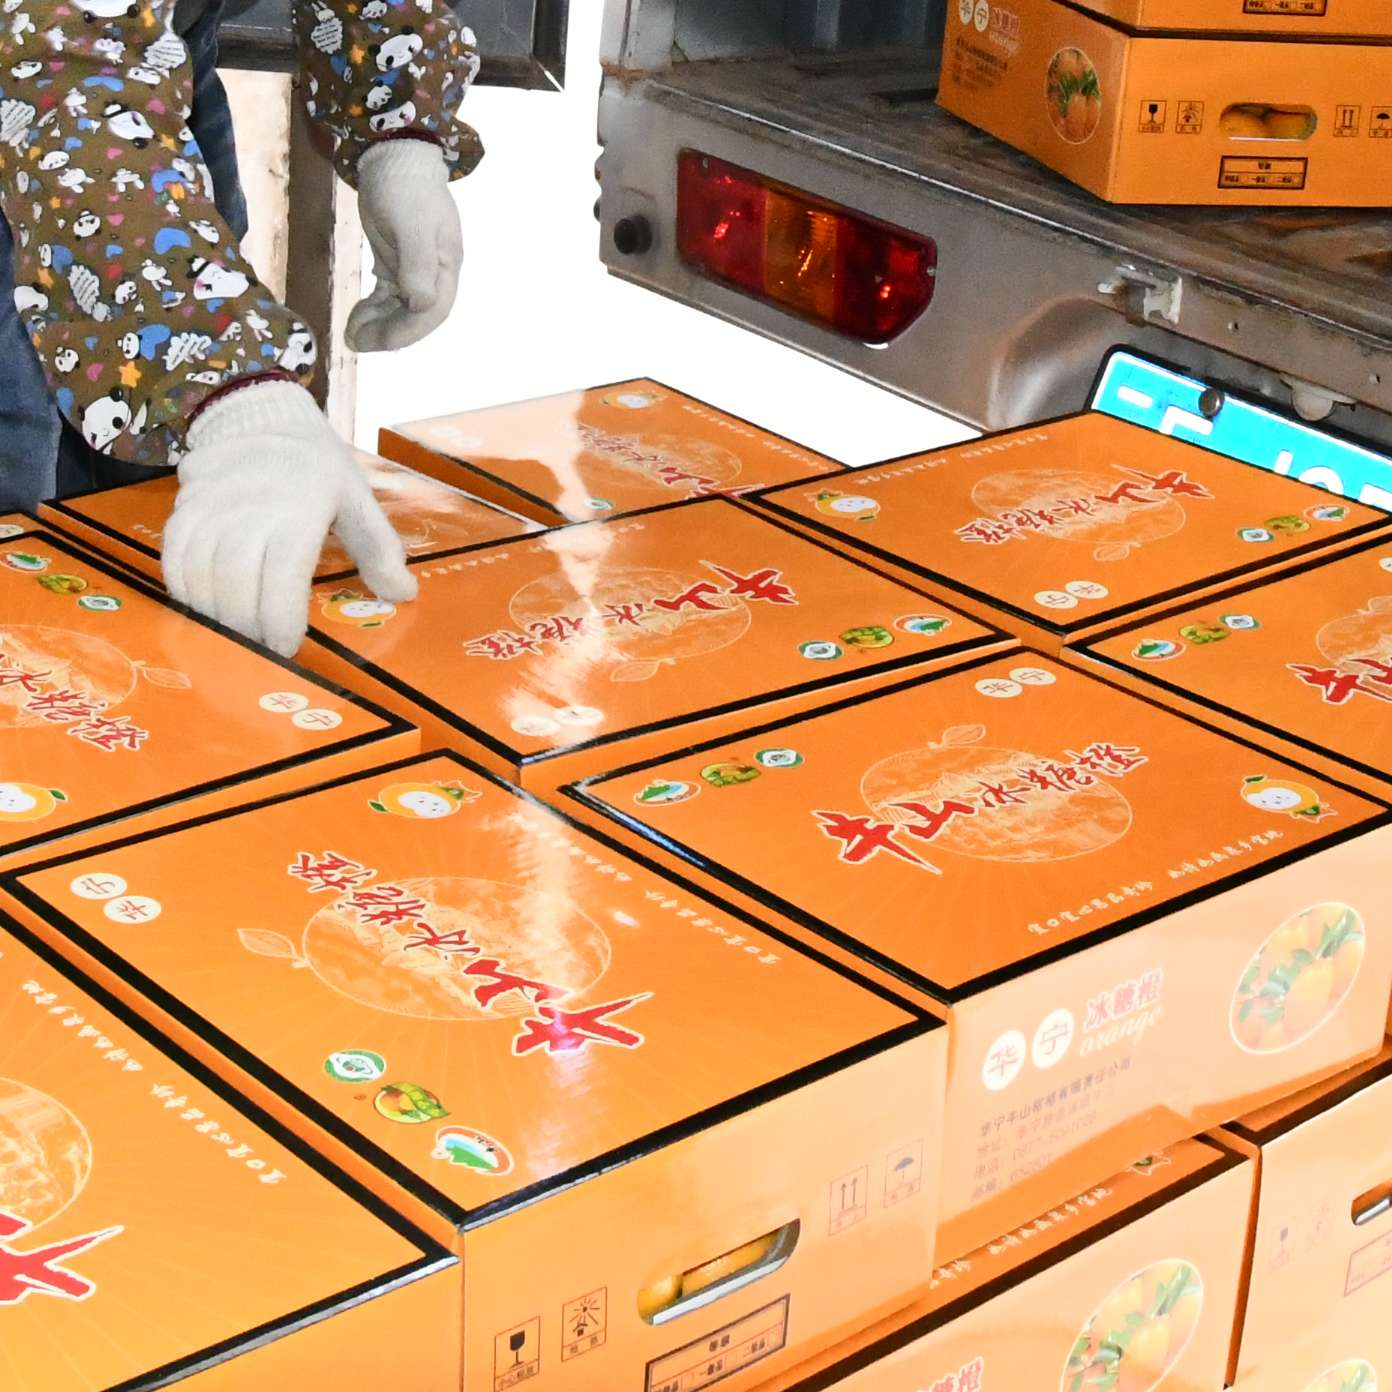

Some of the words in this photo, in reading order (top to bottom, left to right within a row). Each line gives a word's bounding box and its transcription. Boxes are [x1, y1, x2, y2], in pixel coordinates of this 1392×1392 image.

[955, 463, 1215, 547] 牛山冰糖橙
[262, 694, 338, 727] 华宁
[976, 668, 1055, 697] 华宁
[811, 742, 1149, 875] 牛山冰糖橙
[72, 875, 160, 922] 华宁
[287, 850, 653, 1058] 牛山冰糖橙
[984, 1012, 1072, 1087] 华宁
